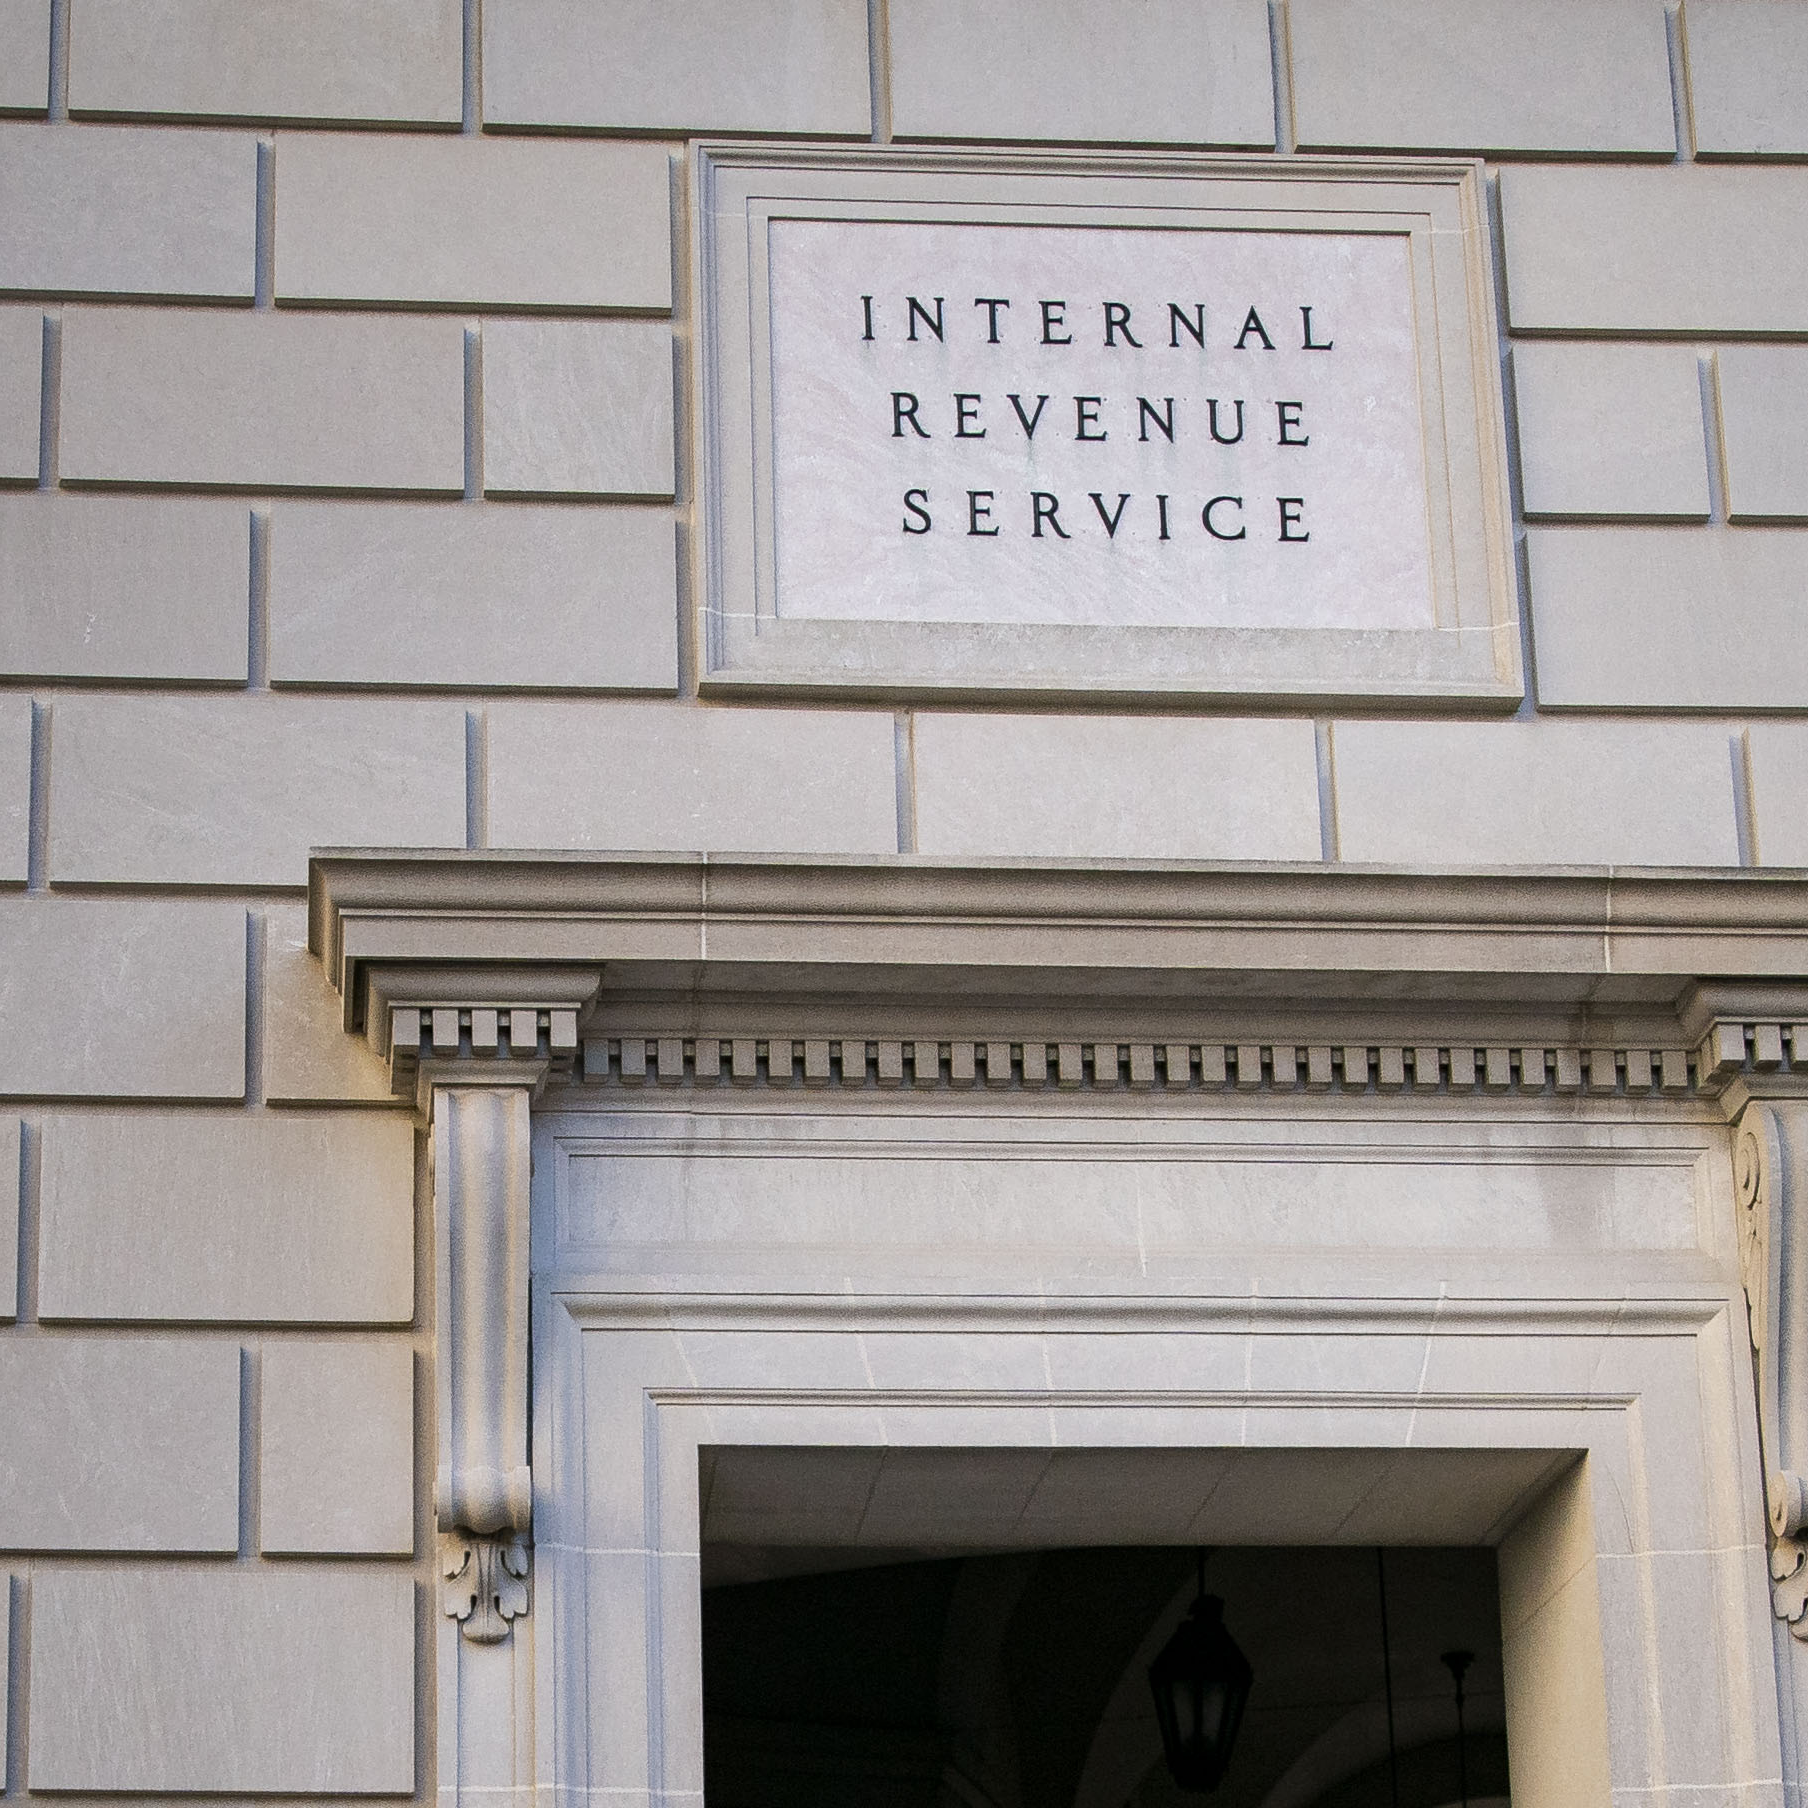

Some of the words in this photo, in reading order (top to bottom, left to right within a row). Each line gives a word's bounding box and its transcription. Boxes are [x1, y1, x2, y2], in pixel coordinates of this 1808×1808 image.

[860, 295, 1334, 351] INTERNAL
[890, 392, 1310, 447] REVENUE
[902, 488, 1310, 543] SERVICE
